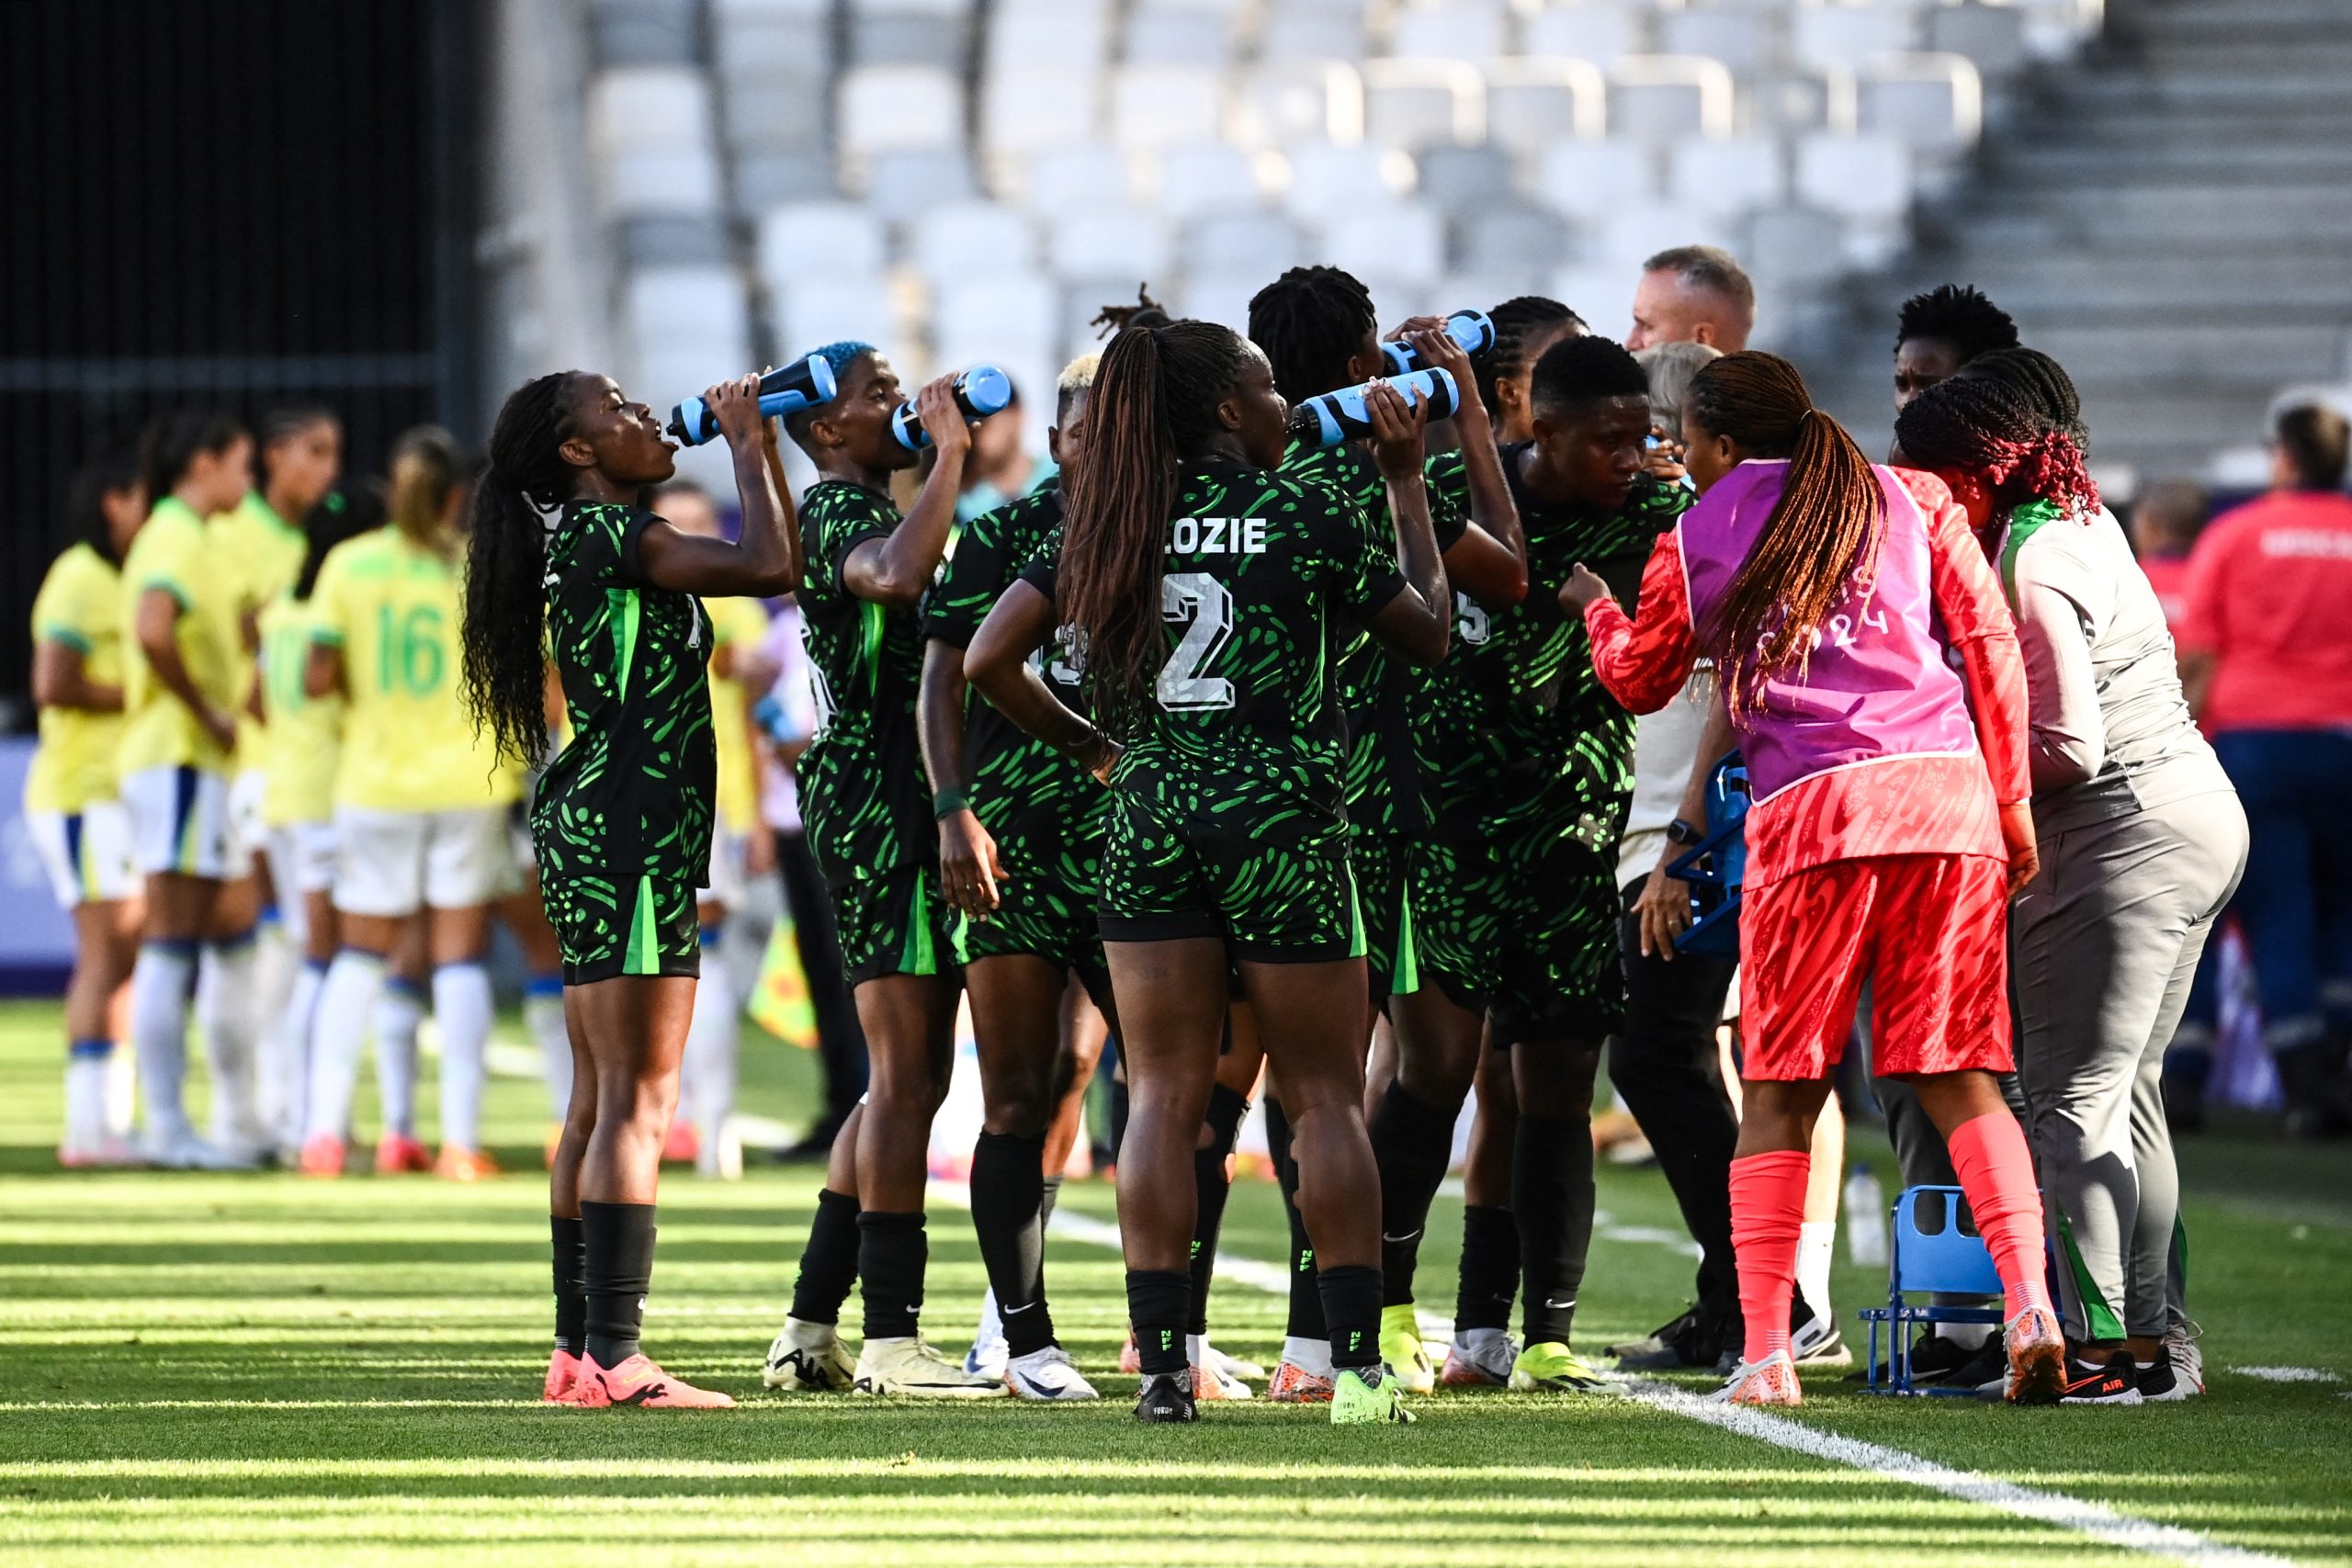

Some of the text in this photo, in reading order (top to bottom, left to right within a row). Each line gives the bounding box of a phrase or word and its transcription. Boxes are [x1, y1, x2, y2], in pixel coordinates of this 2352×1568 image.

[1164, 517, 1267, 554] OZIE
[378, 604, 444, 697] 16
[1156, 571, 1236, 712] 2
[1299, 1249, 1313, 1271] NFF
[1160, 1329, 1172, 1351] NFF
[1349, 1330, 1362, 1352] NFF
[2102, 1379, 2124, 1393] AIR
